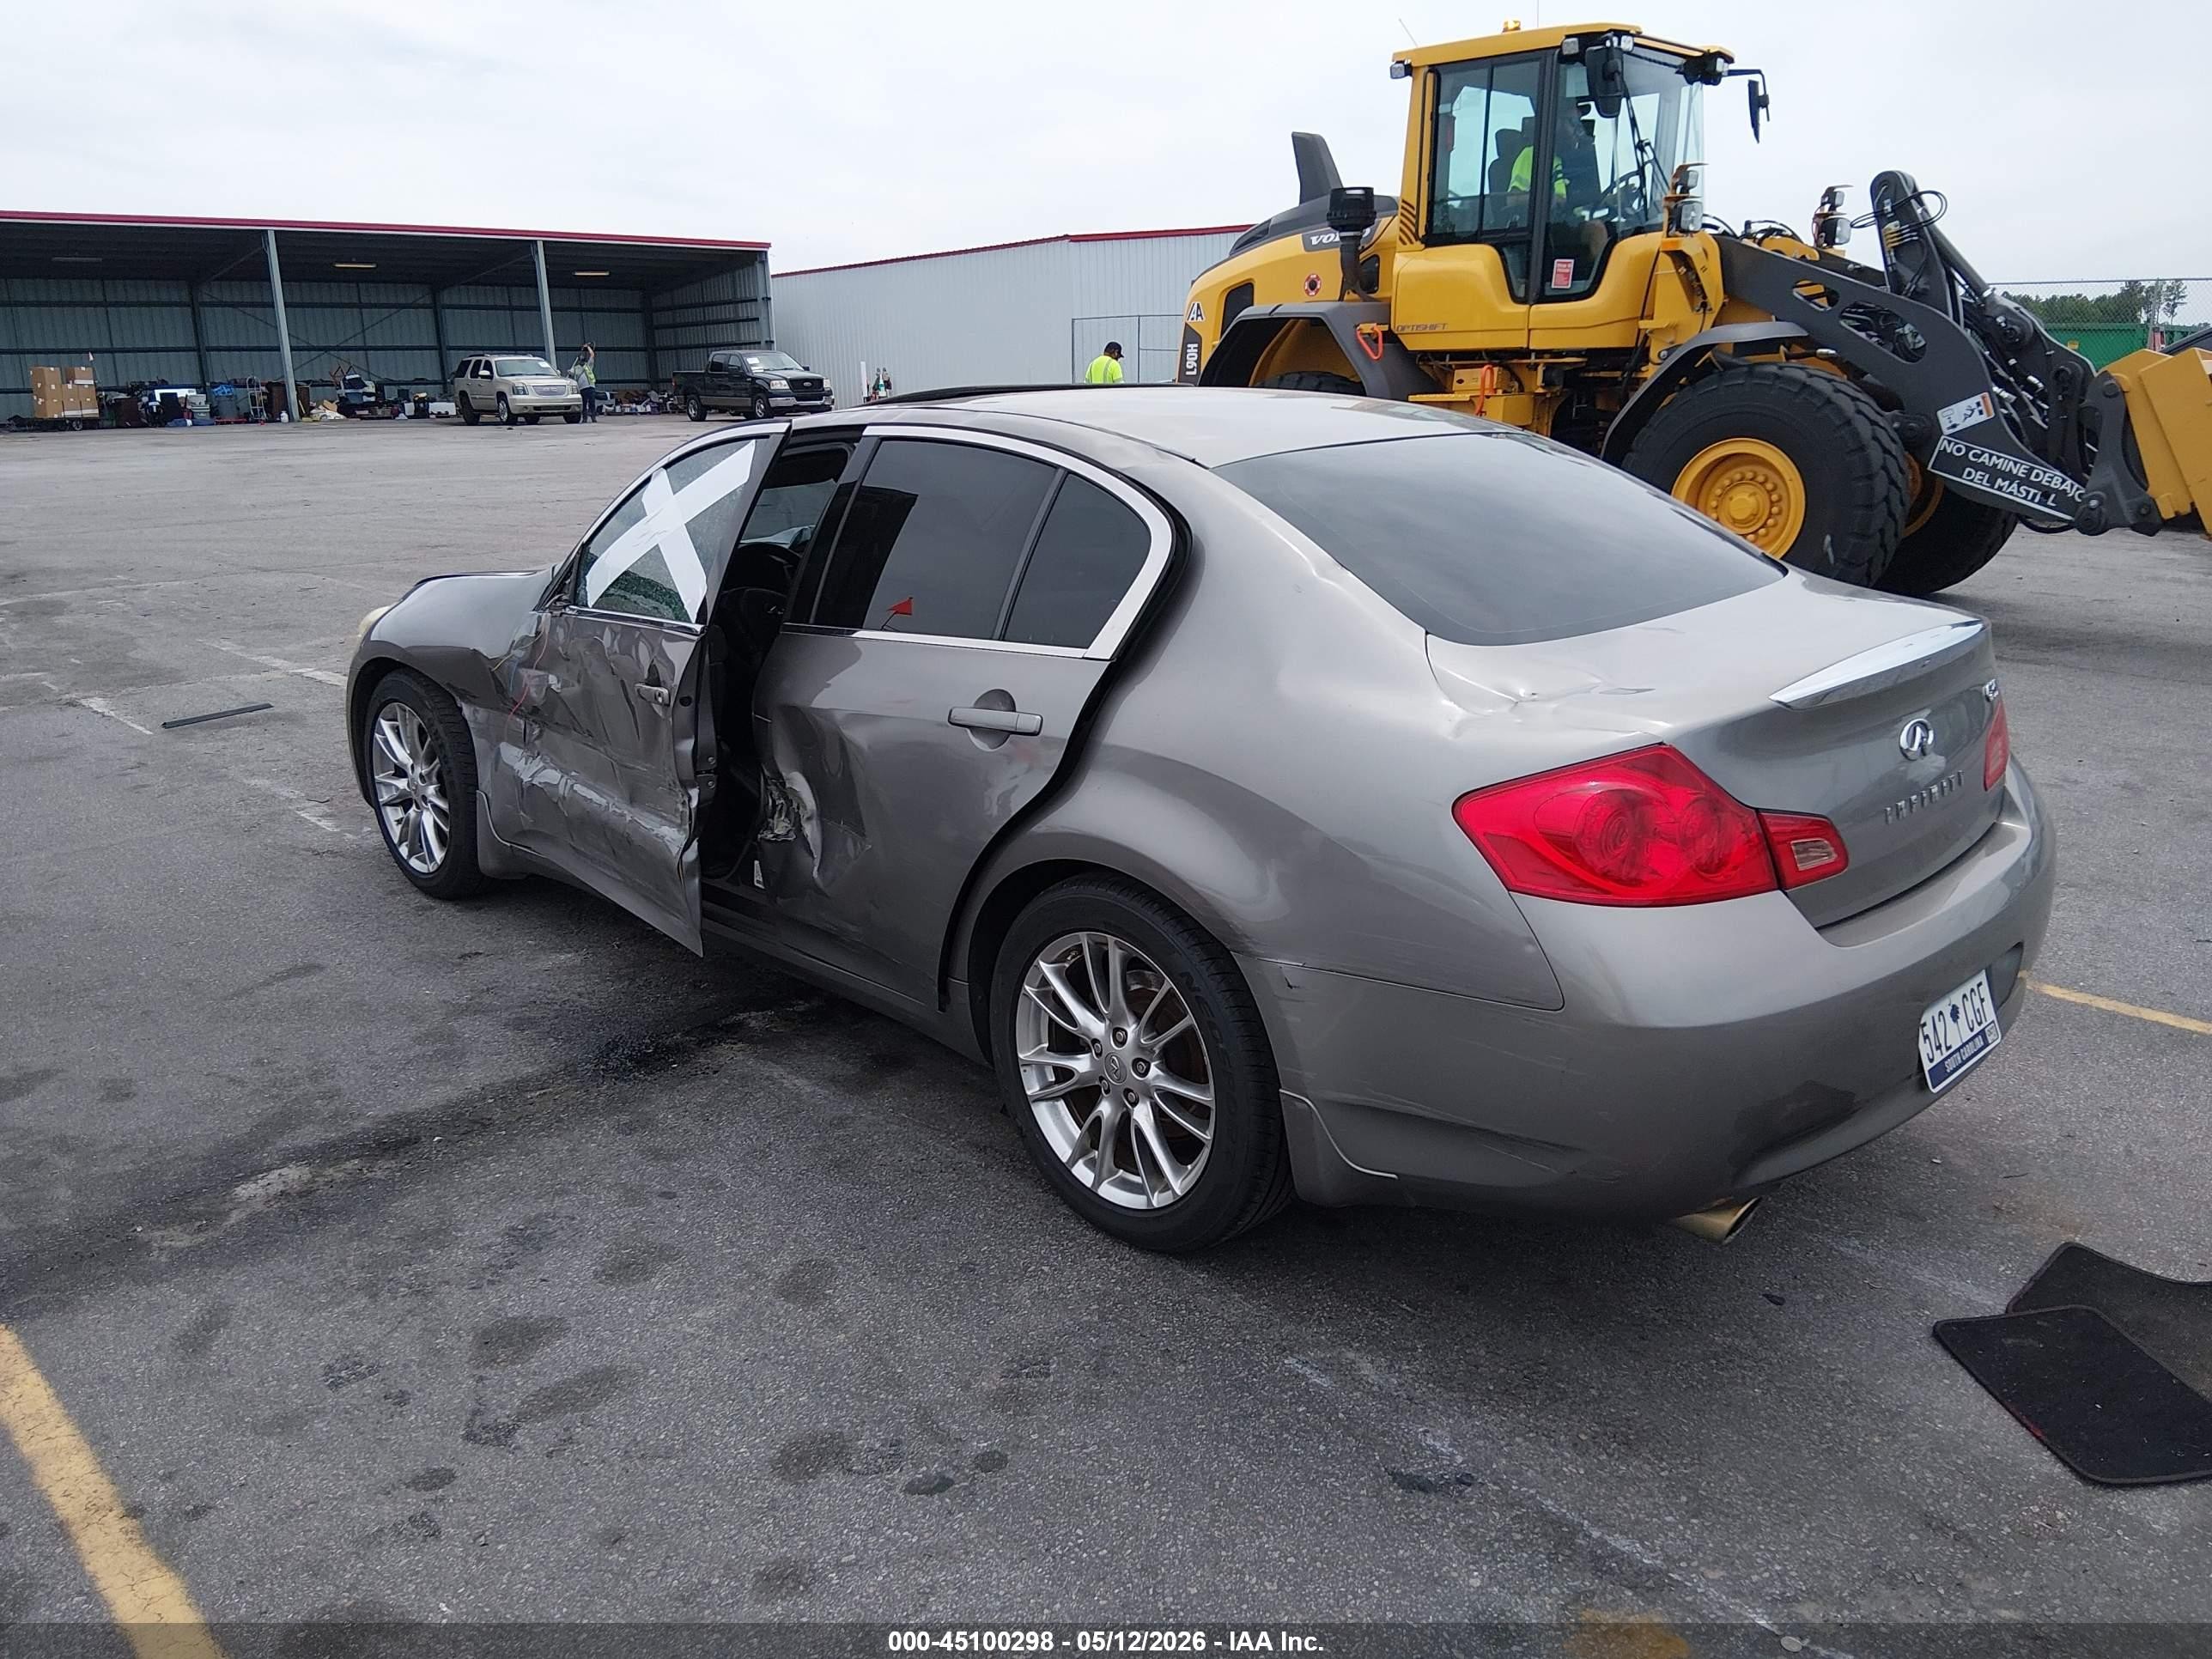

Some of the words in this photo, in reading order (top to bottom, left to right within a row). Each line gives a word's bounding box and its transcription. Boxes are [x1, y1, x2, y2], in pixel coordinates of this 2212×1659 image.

[1310, 228, 1370, 246] VOLO
[1185, 343, 1199, 376] L90H
[1939, 440, 1966, 457] NO
[1968, 449, 2029, 478] CAMINE
[1962, 467, 1991, 487] DEL
[1920, 1010, 1953, 1064] 542
[1961, 981, 1990, 1032] CGF
